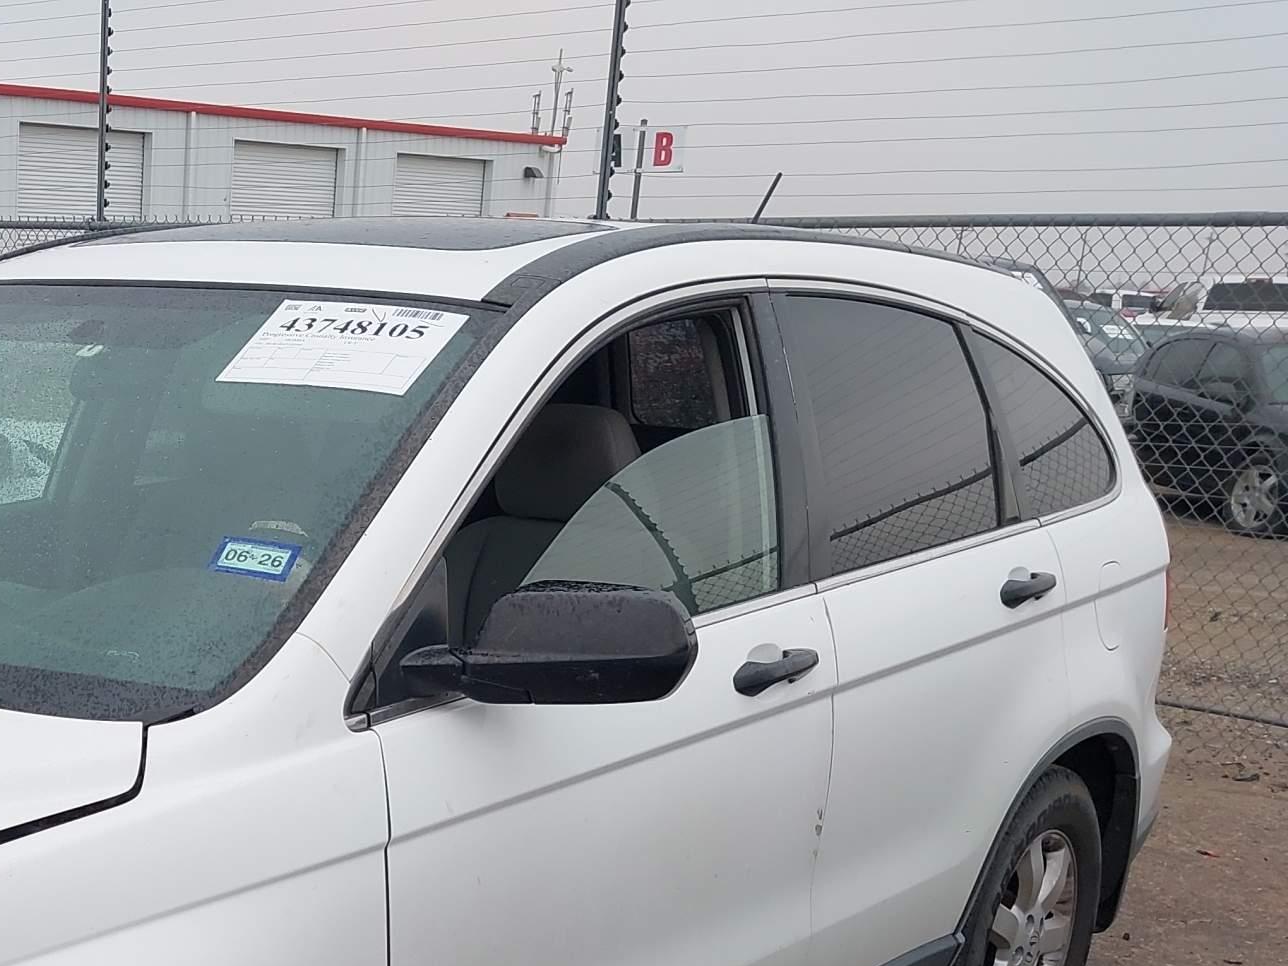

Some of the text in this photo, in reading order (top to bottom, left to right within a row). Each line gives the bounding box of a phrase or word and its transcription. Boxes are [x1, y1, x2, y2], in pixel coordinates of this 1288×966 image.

[653, 131, 673, 167] B
[279, 317, 431, 340] 43748105
[224, 549, 285, 568] 06 26
